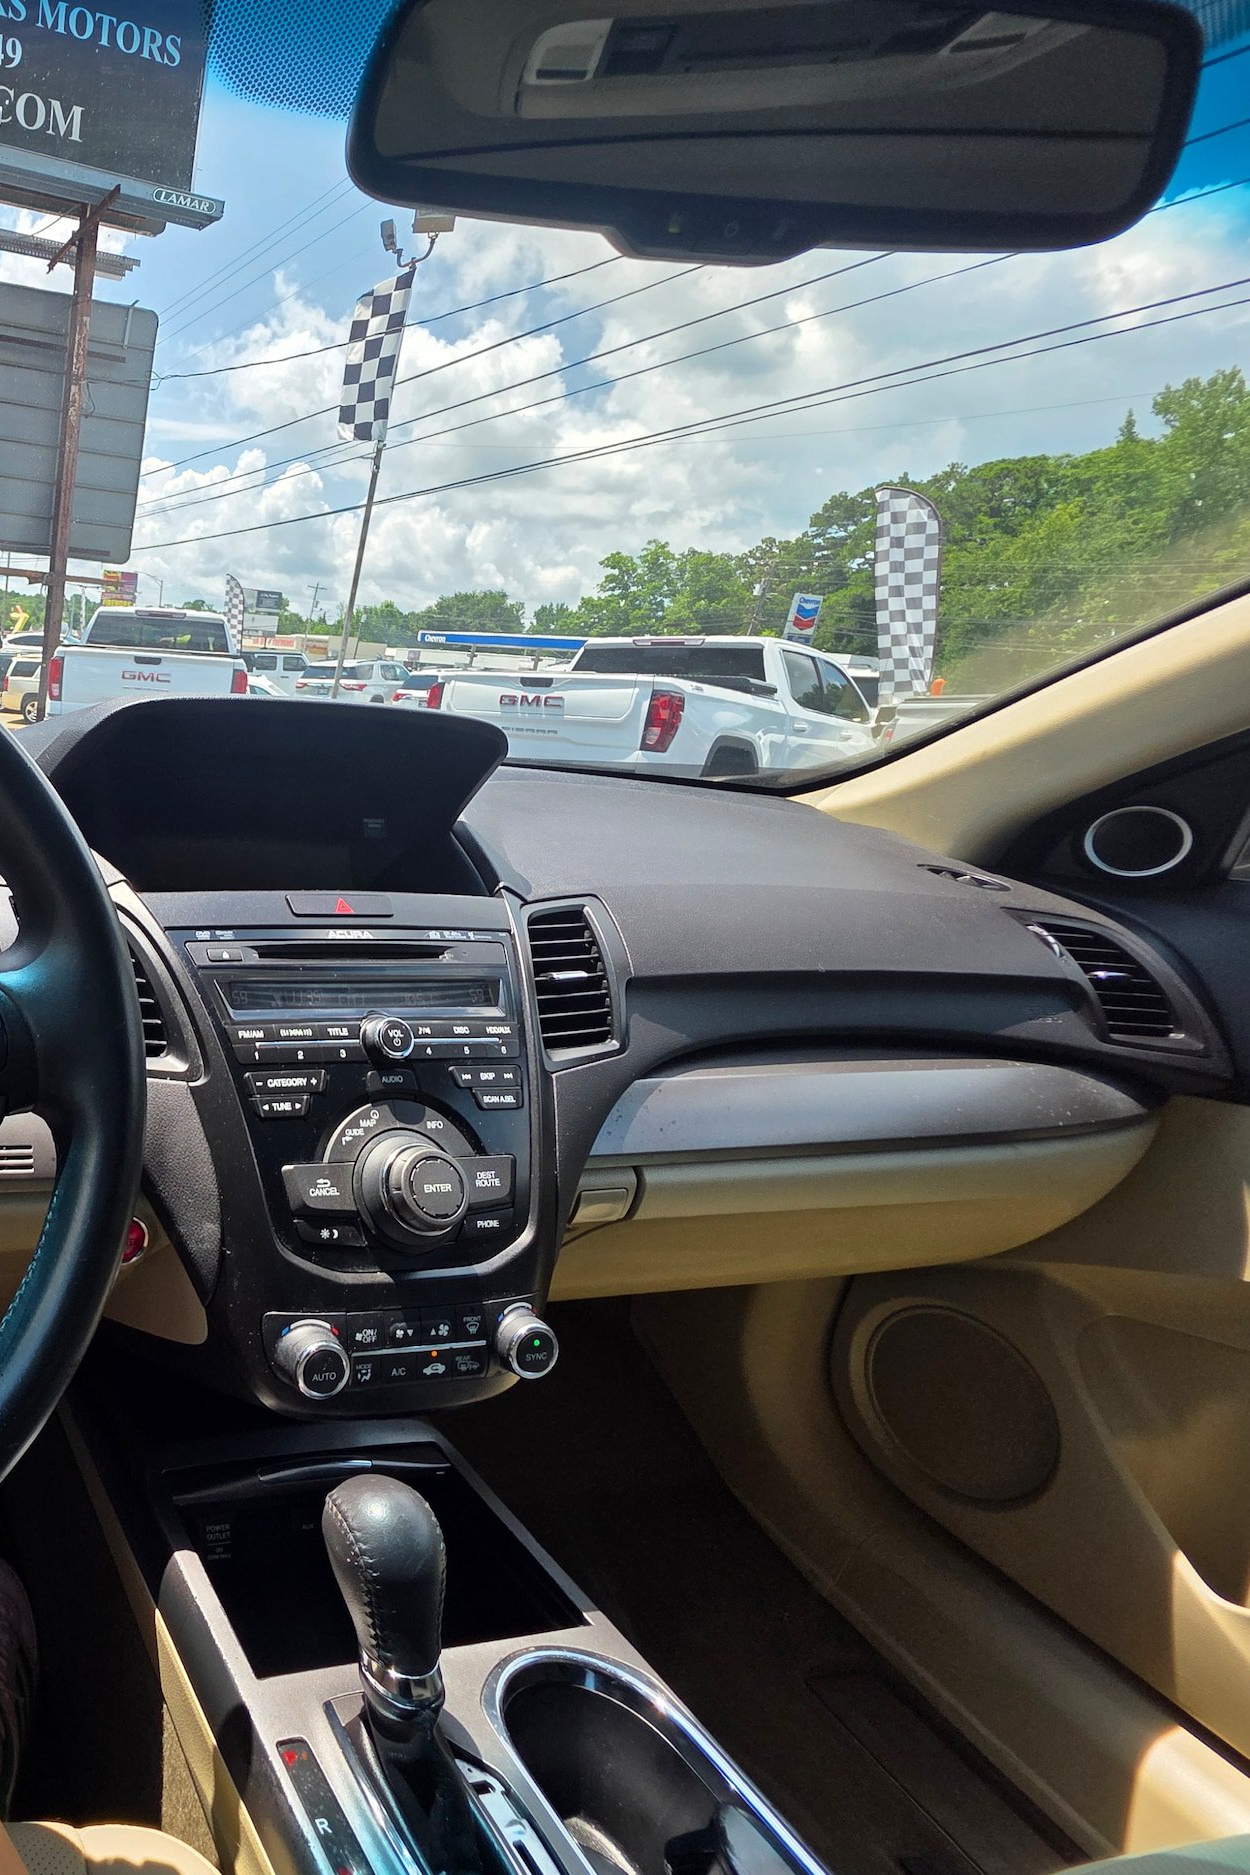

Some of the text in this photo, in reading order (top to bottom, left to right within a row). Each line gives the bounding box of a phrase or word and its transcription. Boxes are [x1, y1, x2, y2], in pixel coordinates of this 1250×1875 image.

[35, 0, 182, 67] MOTORS
[160, 191, 210, 212] LAMAR
[799, 597, 821, 605] Chevron
[424, 635, 447, 643] Chevron
[121, 670, 171, 683] GMC
[499, 694, 565, 708] GMC
[328, 930, 374, 939] ACURA
[238, 1029, 264, 1039] FM/AM
[327, 1027, 349, 1036] TITLE
[387, 1029, 404, 1038] VOL
[453, 1026, 470, 1035] DISC
[339, 1049, 347, 1058] 3
[425, 1046, 432, 1055] 4
[463, 1046, 470, 1055] 5
[501, 1046, 507, 1054] 6
[254, 1051, 260, 1060] 1
[297, 1050, 304, 1060] 2
[381, 1075, 404, 1083] AUDIO
[479, 1072, 496, 1080] SKIP
[267, 1077, 307, 1088] CATEGORY
[272, 1102, 292, 1111] TUNE
[360, 1118, 377, 1128] MAP
[426, 1120, 444, 1129] INFO
[344, 1128, 365, 1136] GUIDE
[476, 1171, 496, 1180] DEST
[475, 1178, 501, 1188] ROUTE
[309, 1187, 340, 1197] CANCEL
[424, 1183, 452, 1193] ENTER
[477, 1219, 500, 1229] PHONE
[463, 1315, 482, 1323] FRONT
[362, 1328, 378, 1338] ON/
[362, 1335, 377, 1344] OFF
[525, 1352, 548, 1362] SYNC
[391, 1366, 407, 1377] A/C
[312, 1372, 337, 1383] AUTO
[206, 1523, 230, 1532] POWER
[314, 1817, 332, 1834] R
